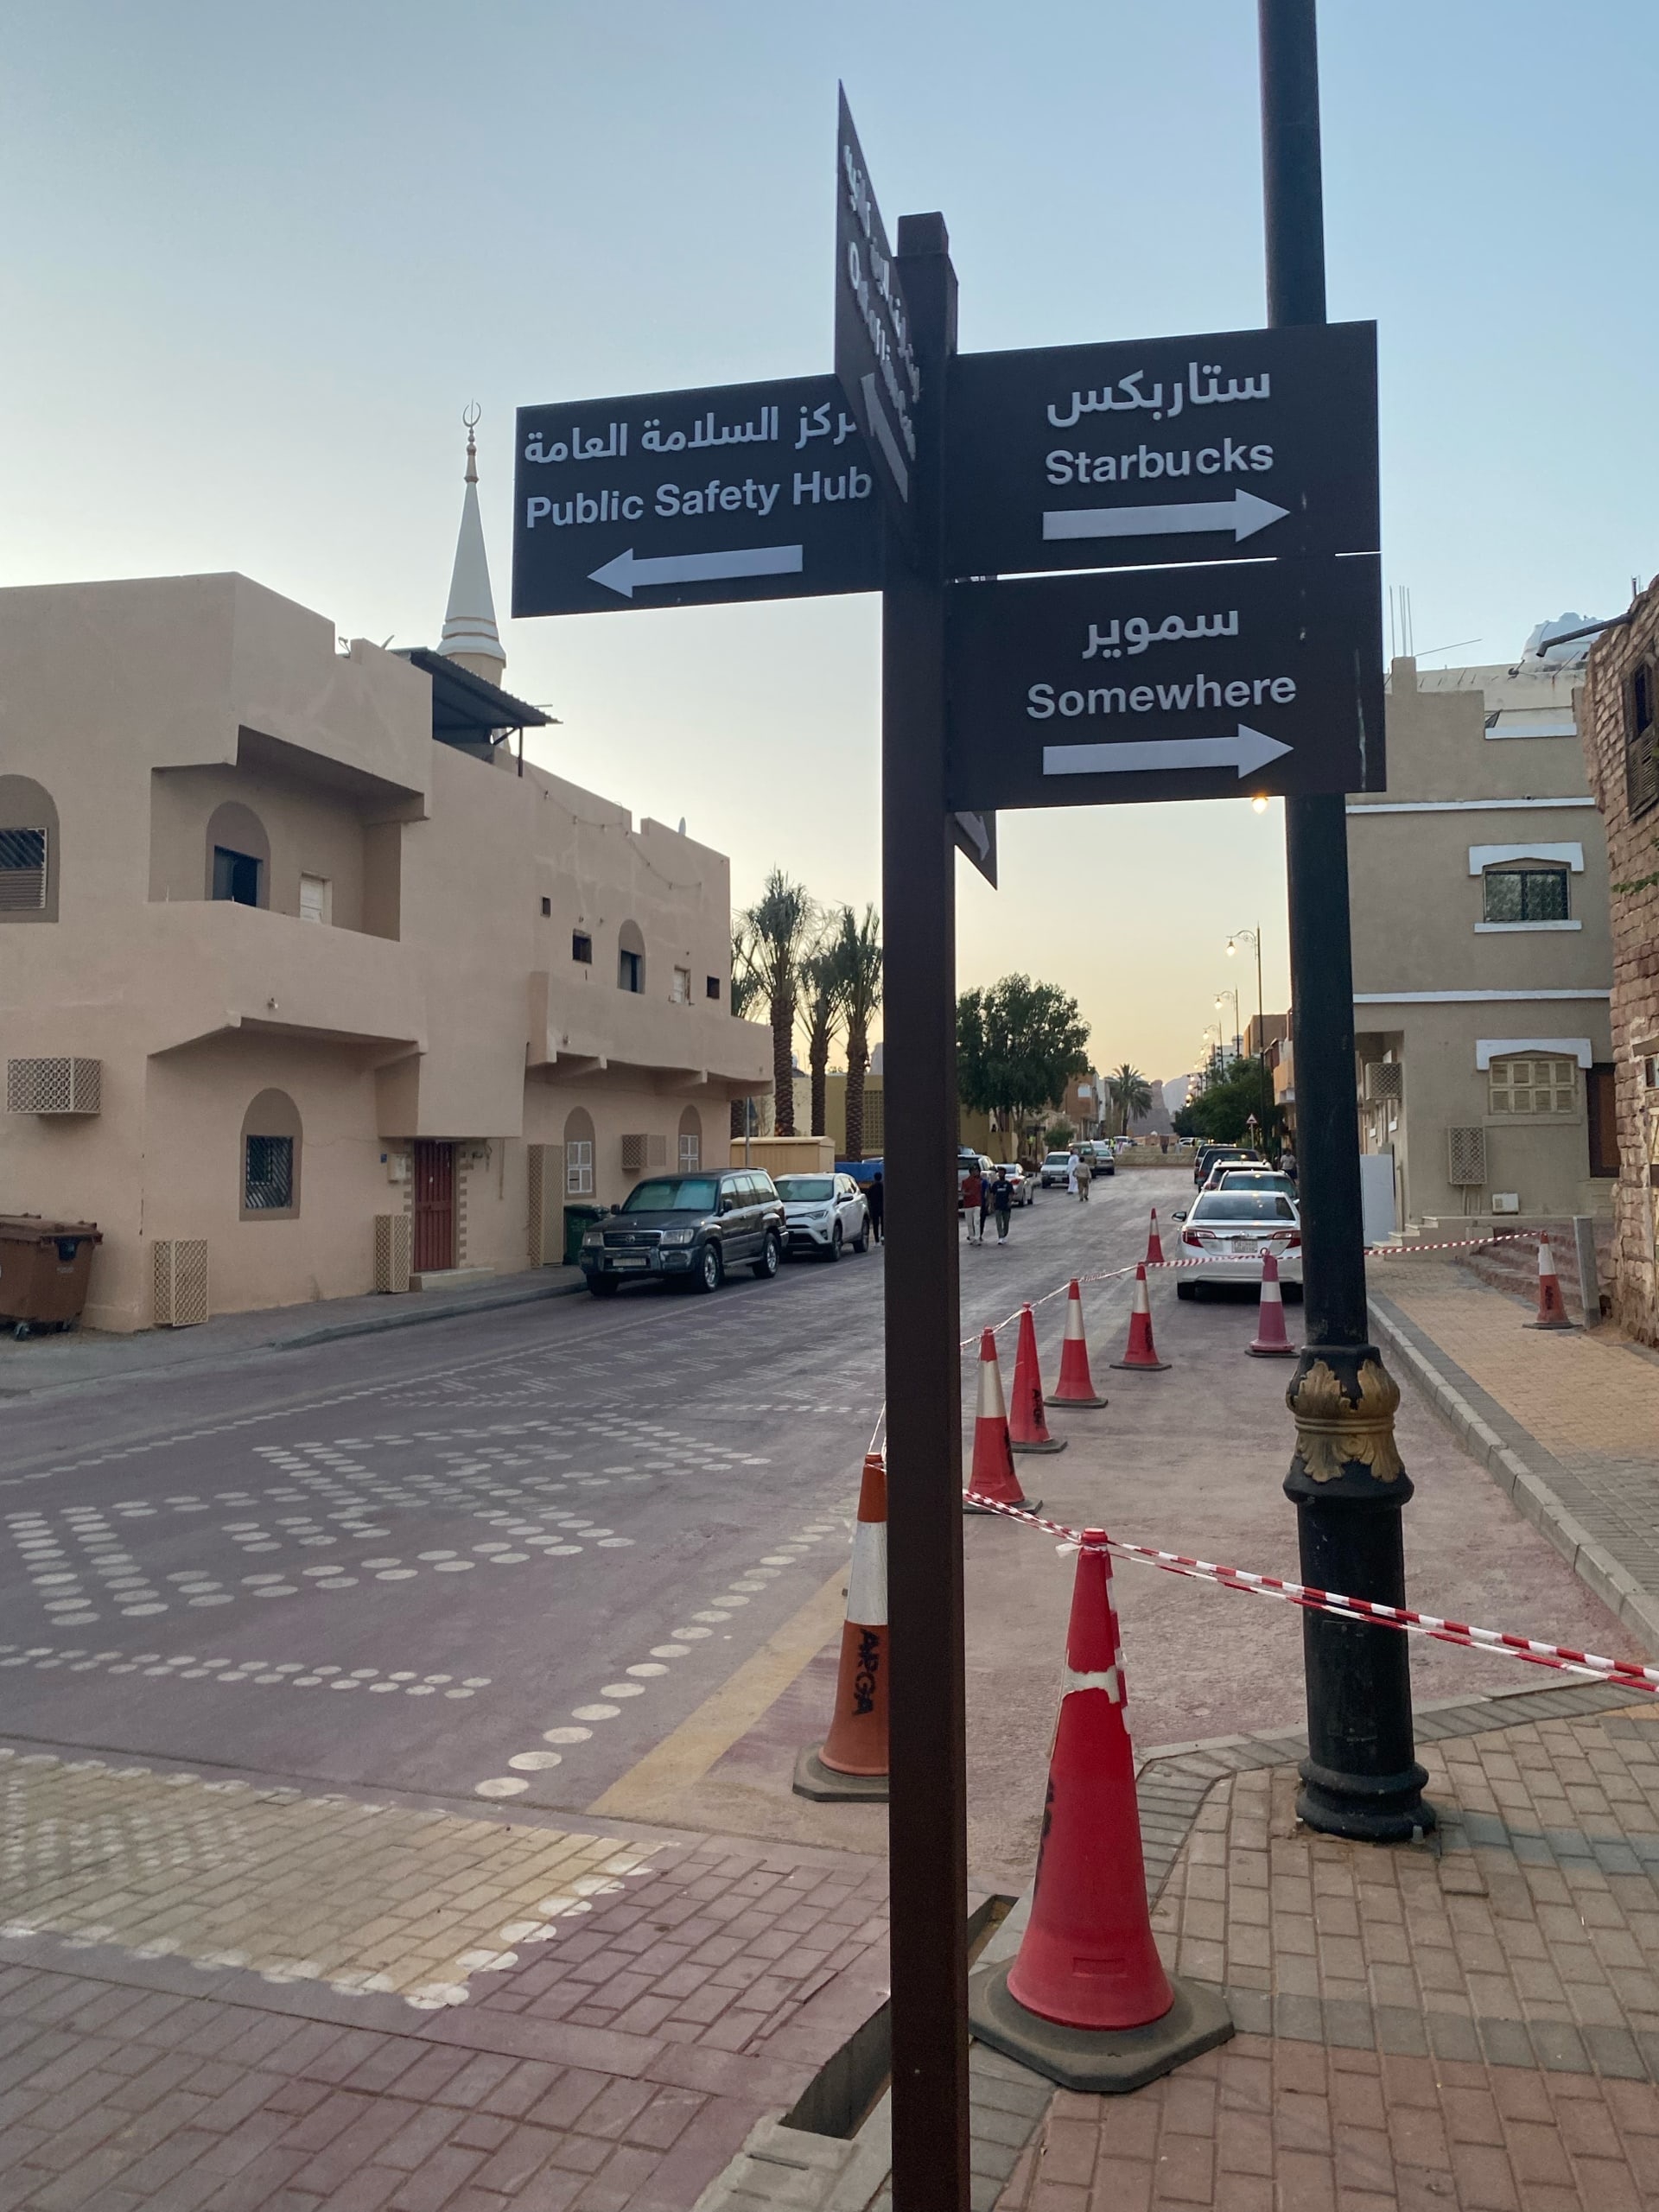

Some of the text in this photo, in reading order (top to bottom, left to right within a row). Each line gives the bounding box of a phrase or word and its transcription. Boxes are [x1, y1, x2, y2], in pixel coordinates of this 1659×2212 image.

[1046, 360, 1271, 428] ستاربكس
[524, 422, 629, 464] العامة
[640, 404, 779, 453] السلامة
[1045, 436, 1274, 486] Starbucks
[526, 466, 873, 529] Public Safety Hub
[1081, 609, 1240, 659] سموير
[1026, 672, 1297, 720] Somewhere
